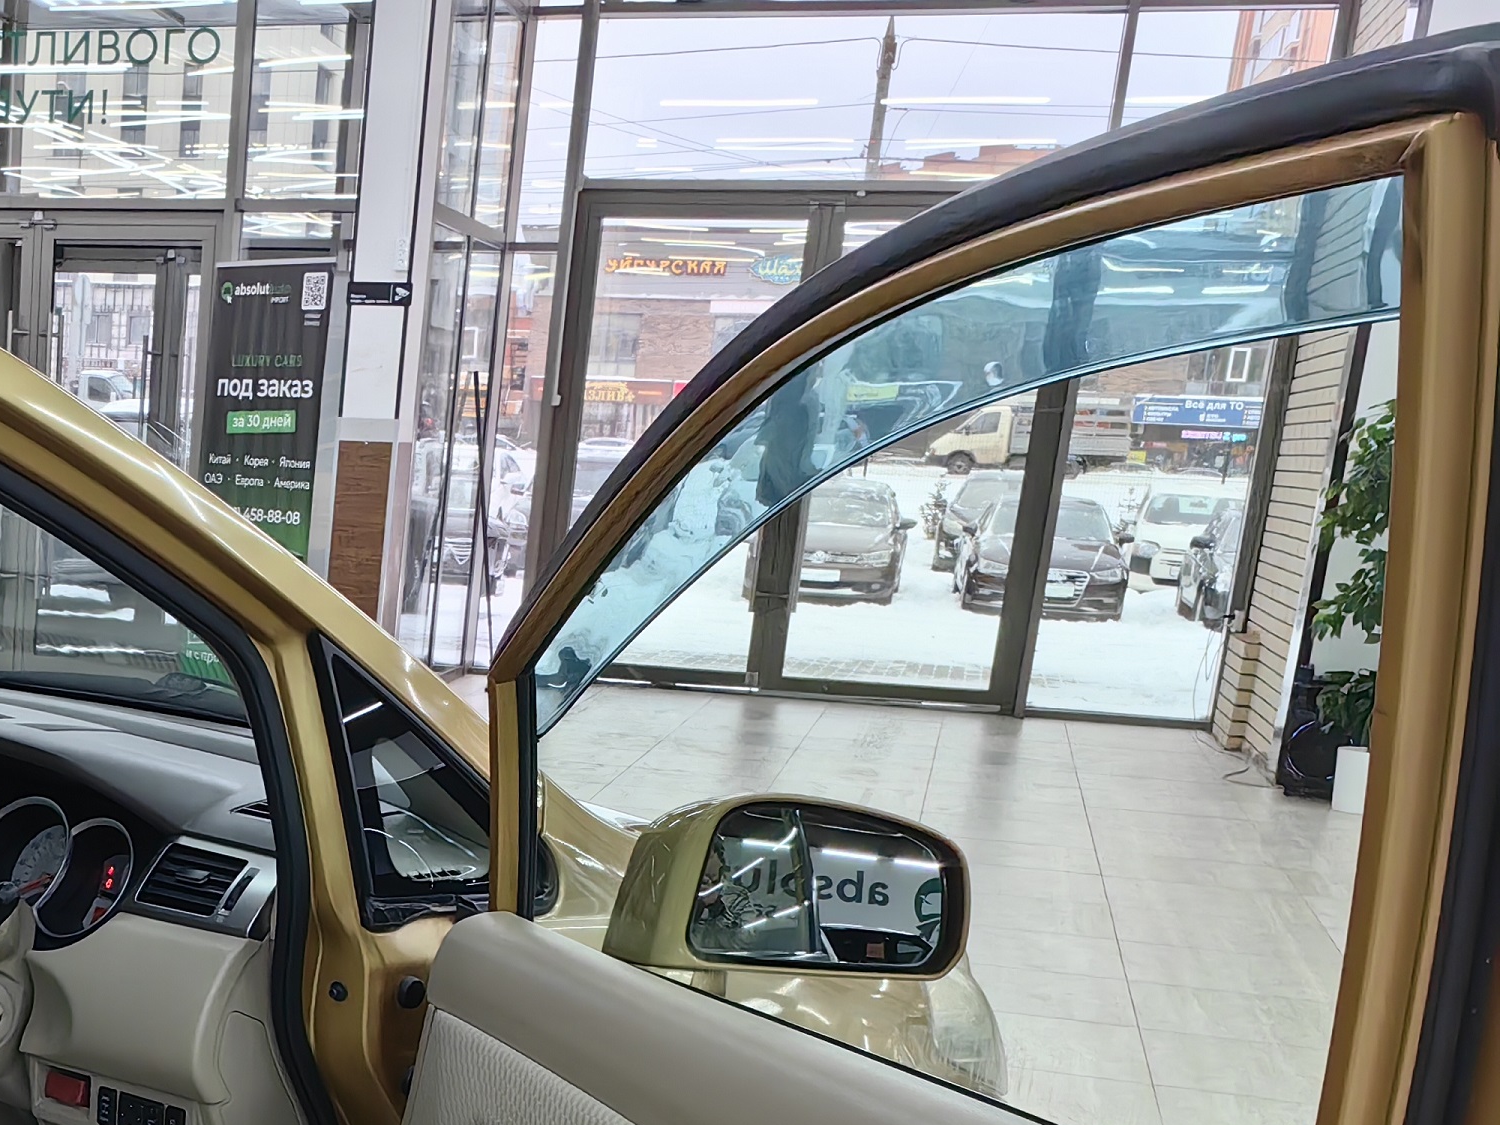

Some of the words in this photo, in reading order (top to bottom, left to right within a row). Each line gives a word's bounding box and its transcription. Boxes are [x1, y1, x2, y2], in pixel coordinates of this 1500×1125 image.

[232, 354, 270, 367] LUXURY
[274, 354, 302, 367] CARS
[217, 379, 253, 399] под
[258, 379, 313, 398] заказ
[1230, 401, 1245, 411] ТО
[232, 417, 245, 428] за
[247, 415, 260, 428] 30
[262, 415, 291, 429] дней
[209, 453, 231, 465] Китай
[244, 454, 268, 468] Корея
[279, 456, 310, 469] Япония
[204, 473, 223, 484] ОАЭ
[235, 474, 264, 488] Европа
[274, 477, 310, 491] Америка
